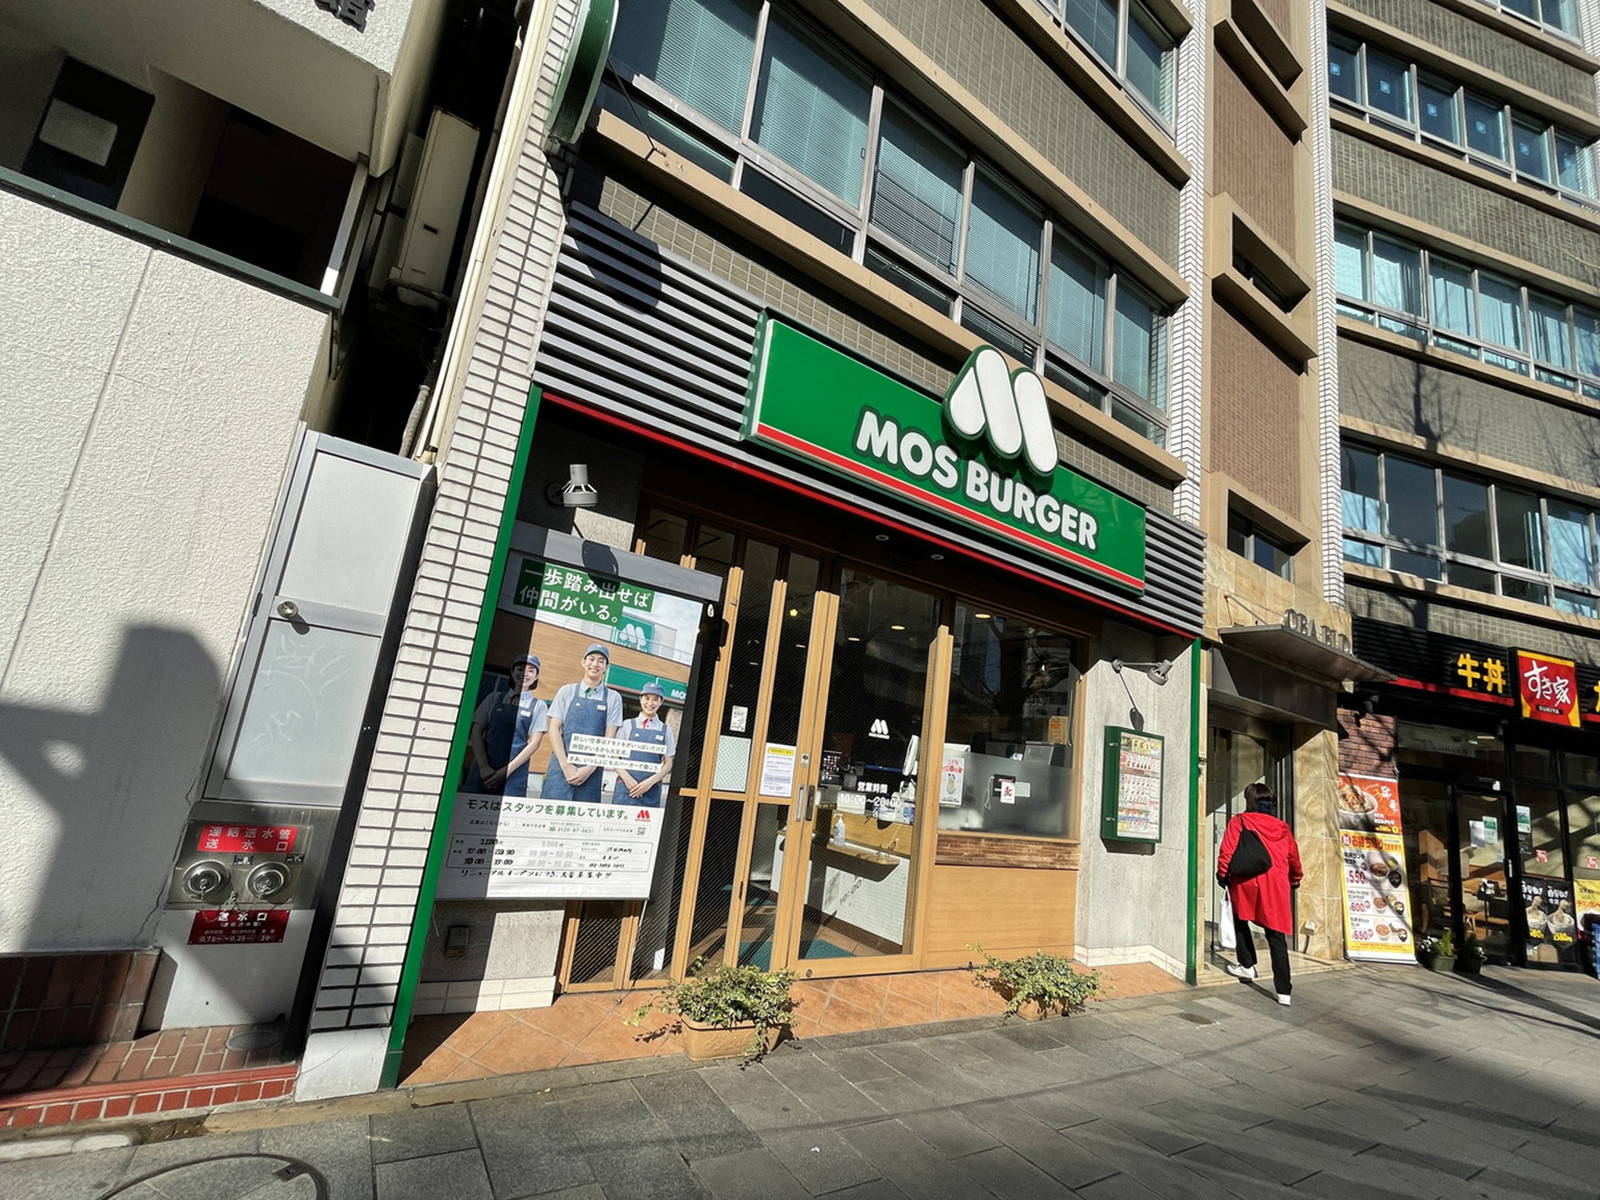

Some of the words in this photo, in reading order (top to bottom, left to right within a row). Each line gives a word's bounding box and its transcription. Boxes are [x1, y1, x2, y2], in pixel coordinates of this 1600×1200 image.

[856, 410, 958, 488] MOS
[966, 459, 1098, 550] BURGER
[520, 585, 618, 624] 仲間がいる。
[525, 568, 651, 608] 一歩踏み出せば
[1457, 653, 1506, 694] 牛丼
[1524, 660, 1571, 707] すき家
[857, 781, 888, 795] 営業時間
[466, 799, 628, 820] モスはスタッフを募集しています。
[204, 839, 288, 852] 送水口
